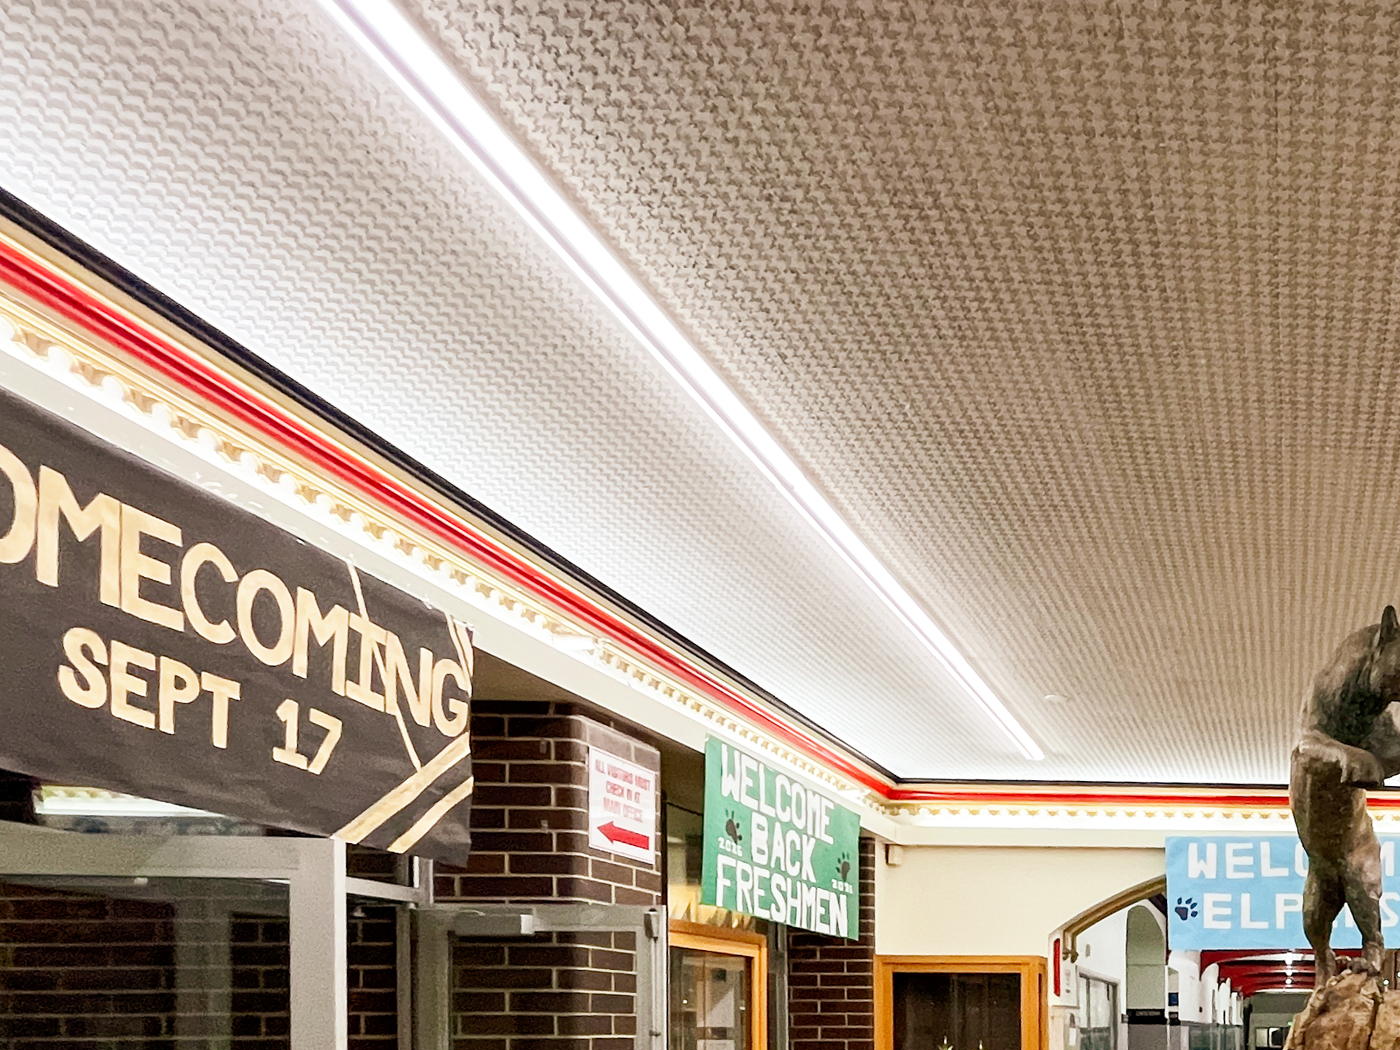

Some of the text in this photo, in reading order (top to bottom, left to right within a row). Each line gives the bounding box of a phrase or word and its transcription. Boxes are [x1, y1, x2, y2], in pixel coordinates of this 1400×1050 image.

[58, 627, 342, 775] SEPT 17
[720, 743, 834, 845] WELCOME
[750, 812, 816, 883] BACK
[716, 854, 848, 937] FRESHMEN
